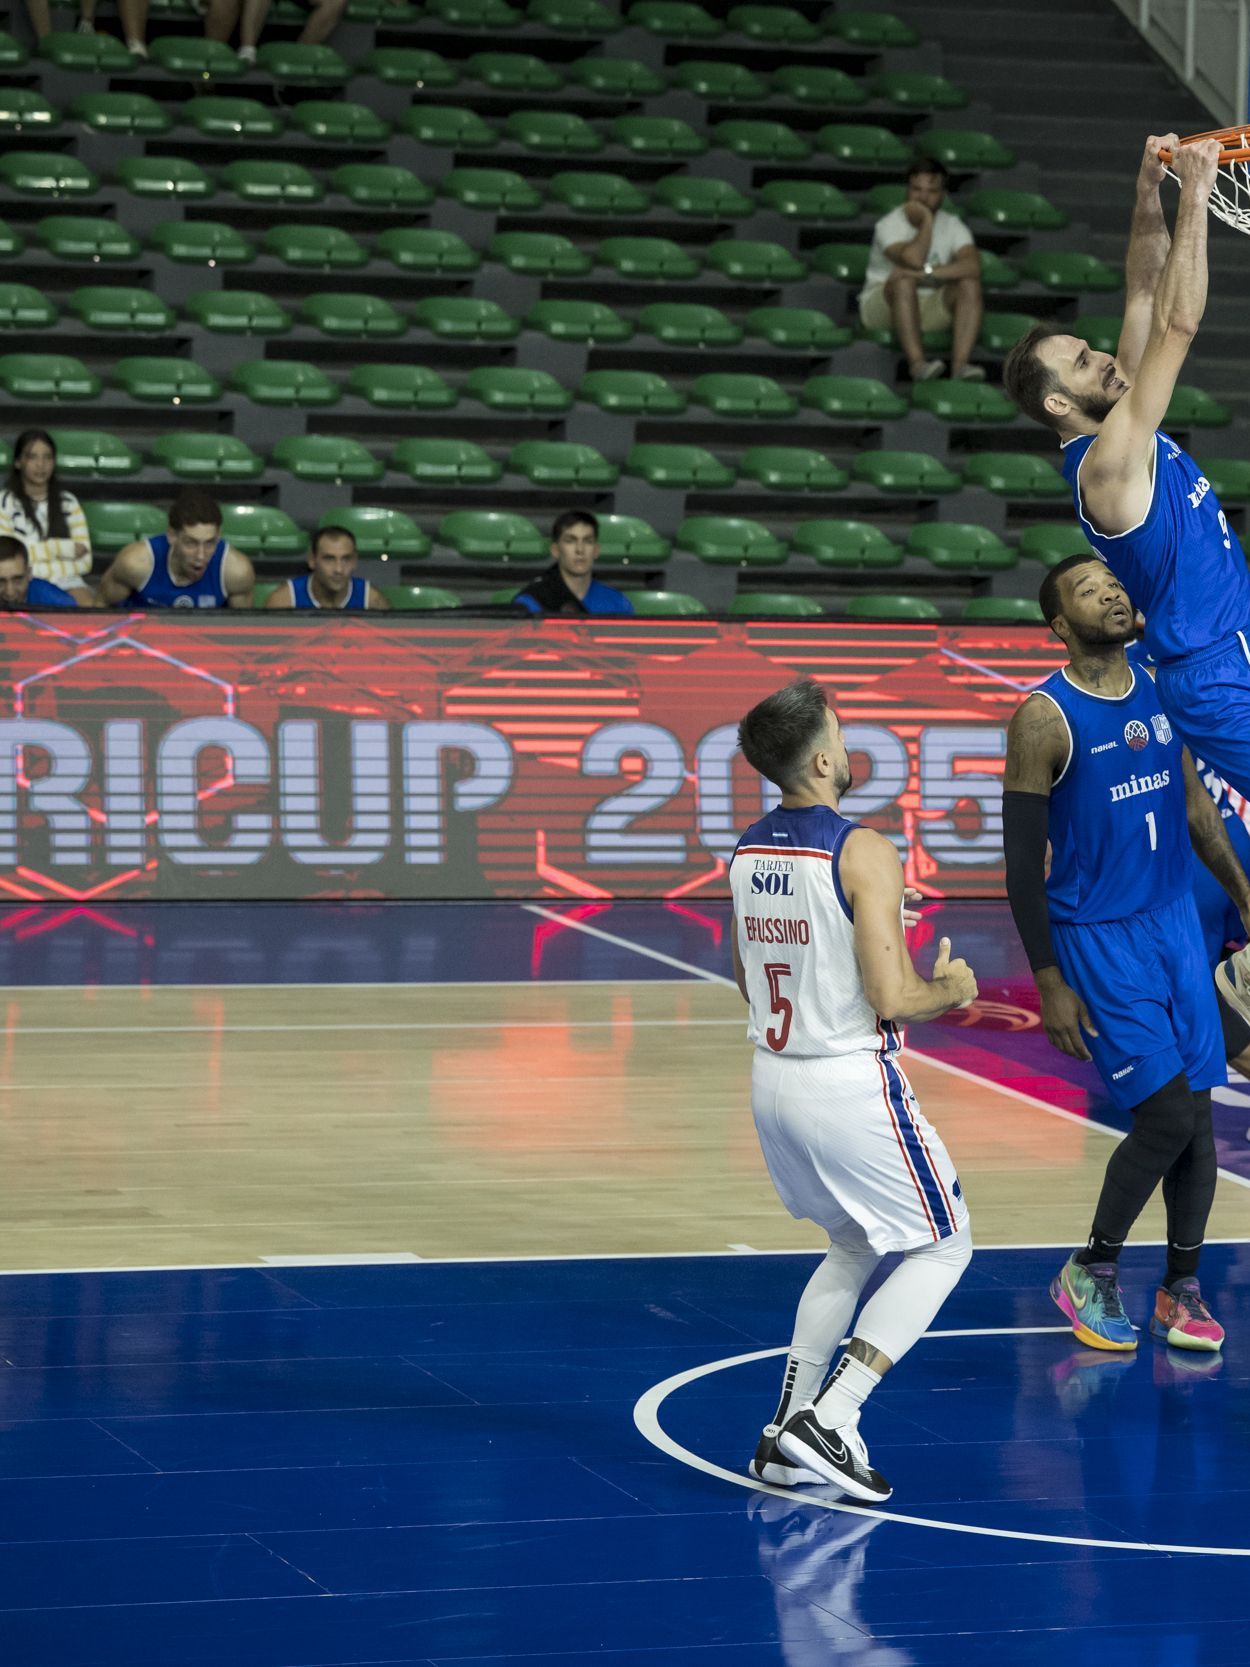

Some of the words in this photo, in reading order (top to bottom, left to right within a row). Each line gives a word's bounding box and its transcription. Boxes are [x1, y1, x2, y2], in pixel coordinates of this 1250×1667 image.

[1109, 770, 1170, 802] minas
[1145, 811, 1157, 851] 1
[754, 859, 794, 872] TARJETA
[751, 871, 794, 896] SOL
[764, 963, 794, 1052] 5
